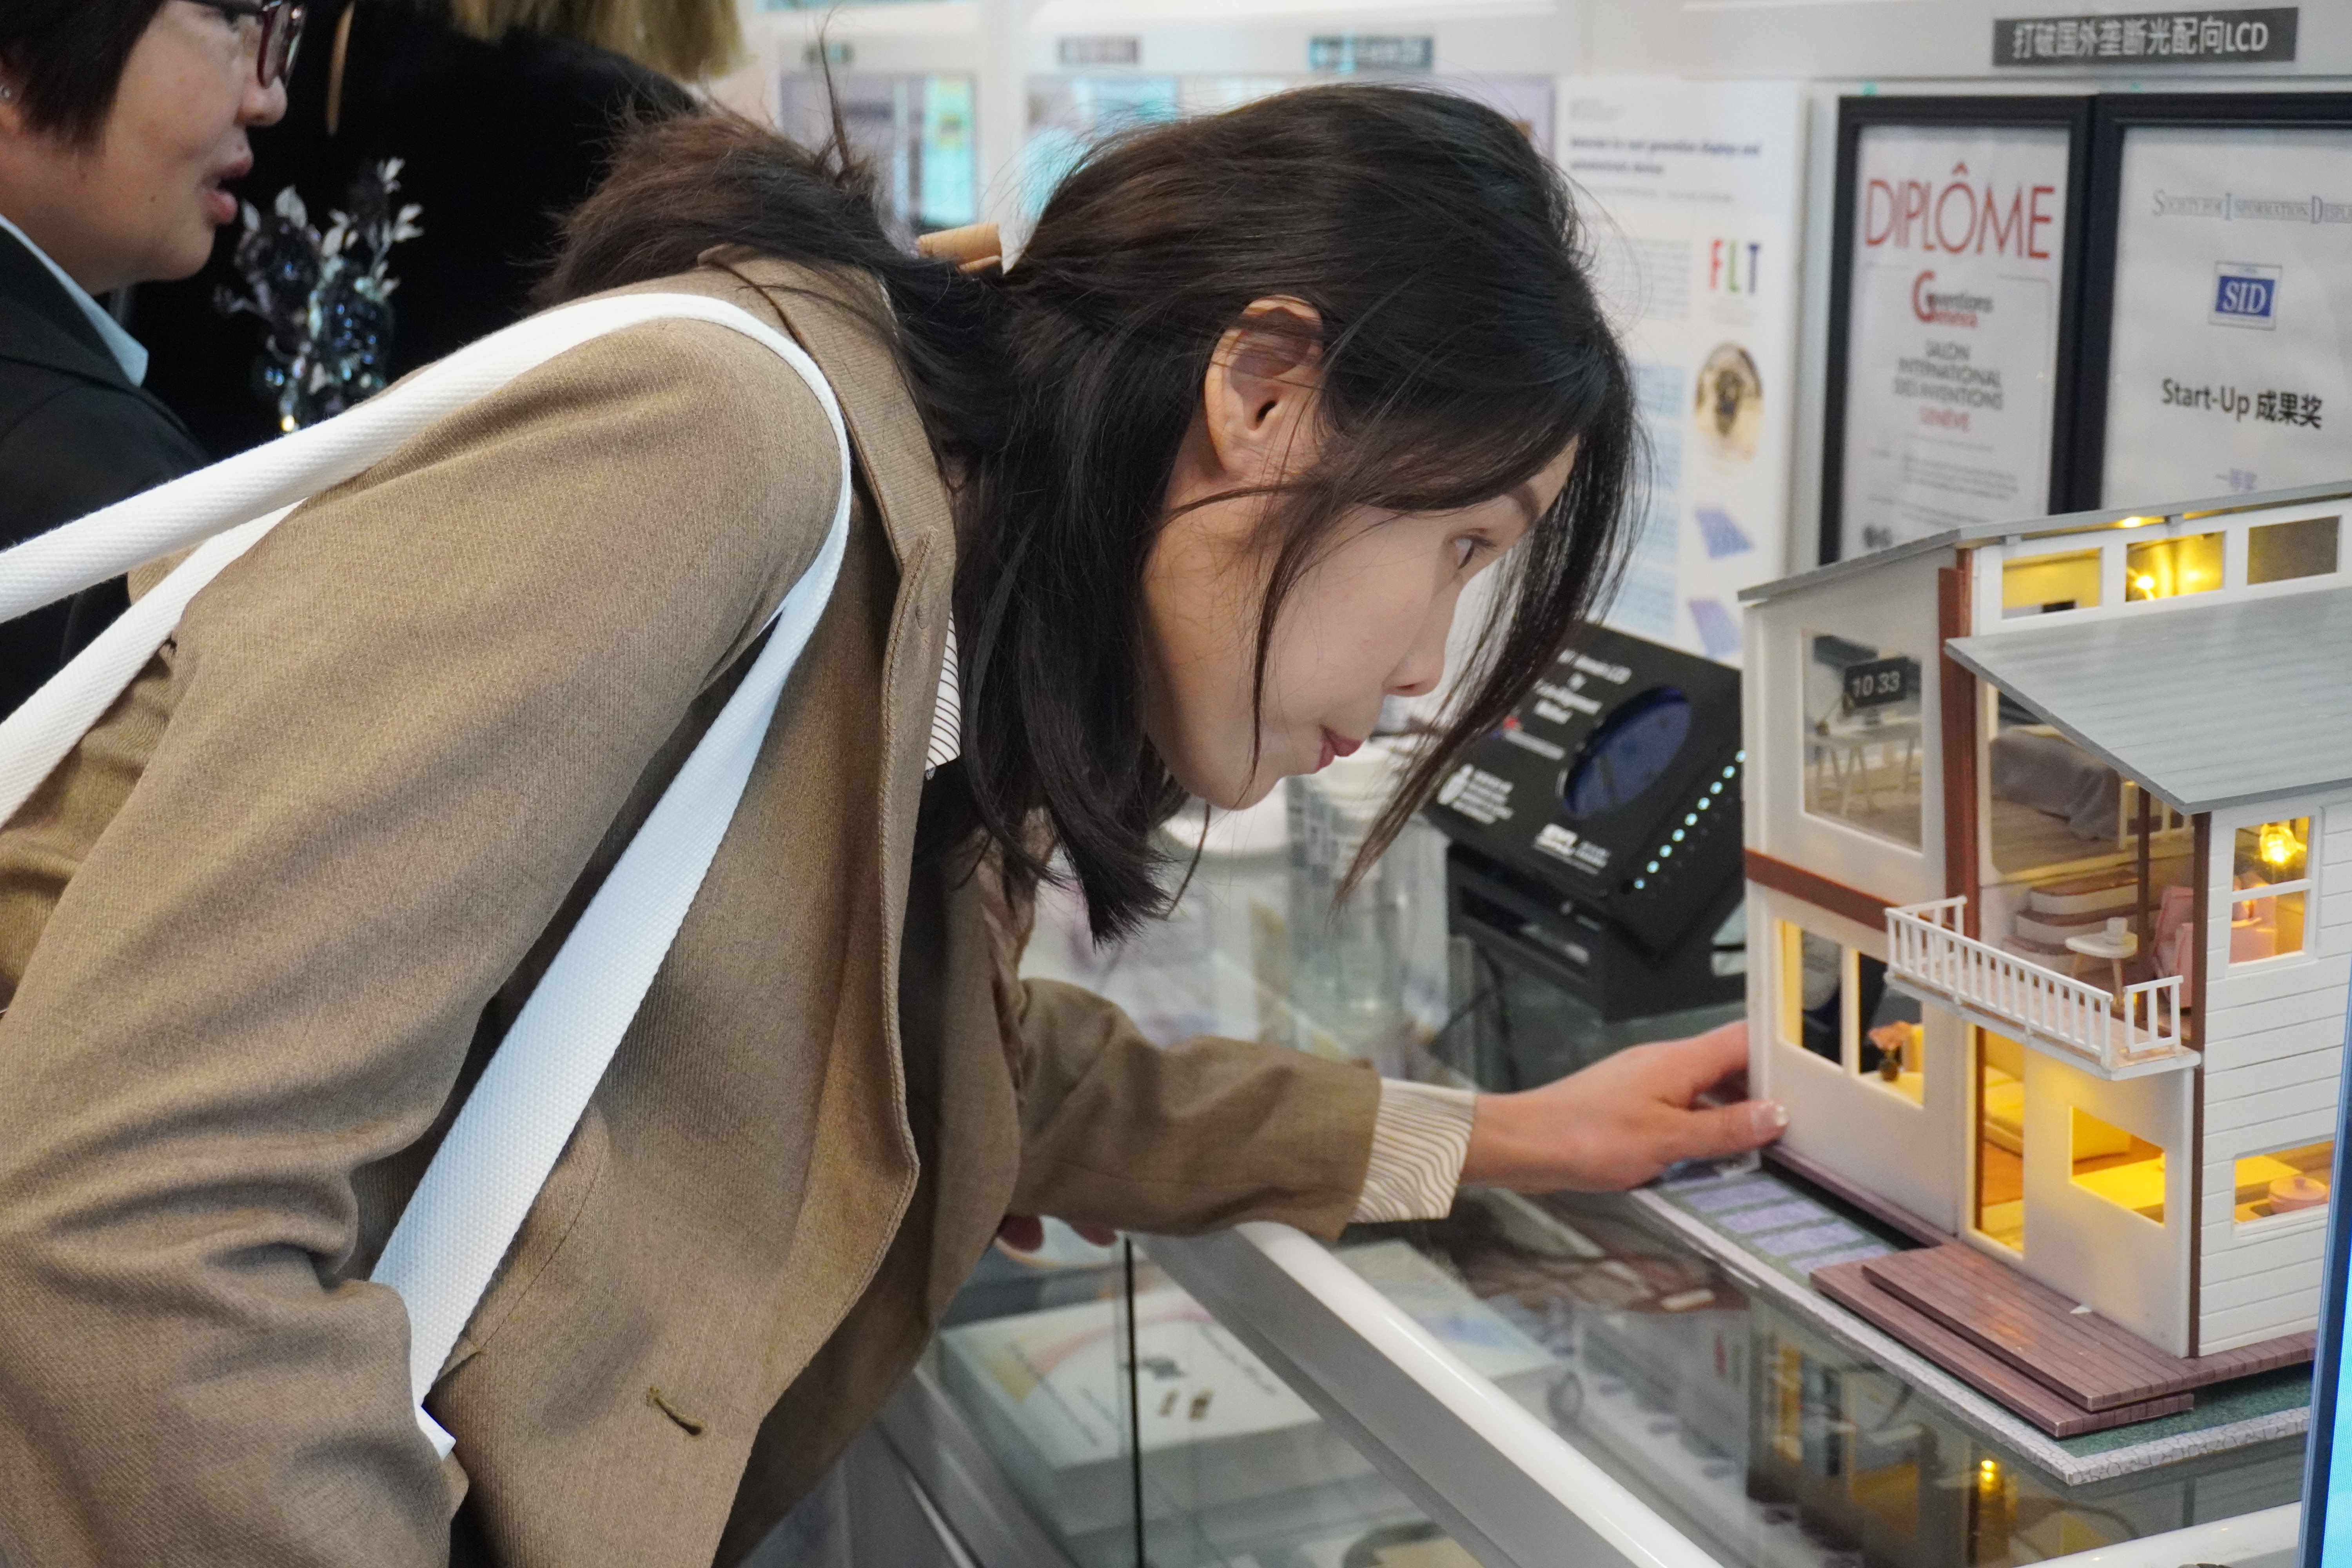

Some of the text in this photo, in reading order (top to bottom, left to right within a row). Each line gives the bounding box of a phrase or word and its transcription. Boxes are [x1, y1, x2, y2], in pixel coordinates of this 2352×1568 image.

[1866, 162, 2055, 259] DIPLÔME
[1710, 239, 1760, 295] FLT
[2222, 281, 2266, 313] SID
[2161, 377, 2323, 430] Start-Up 成果奖
